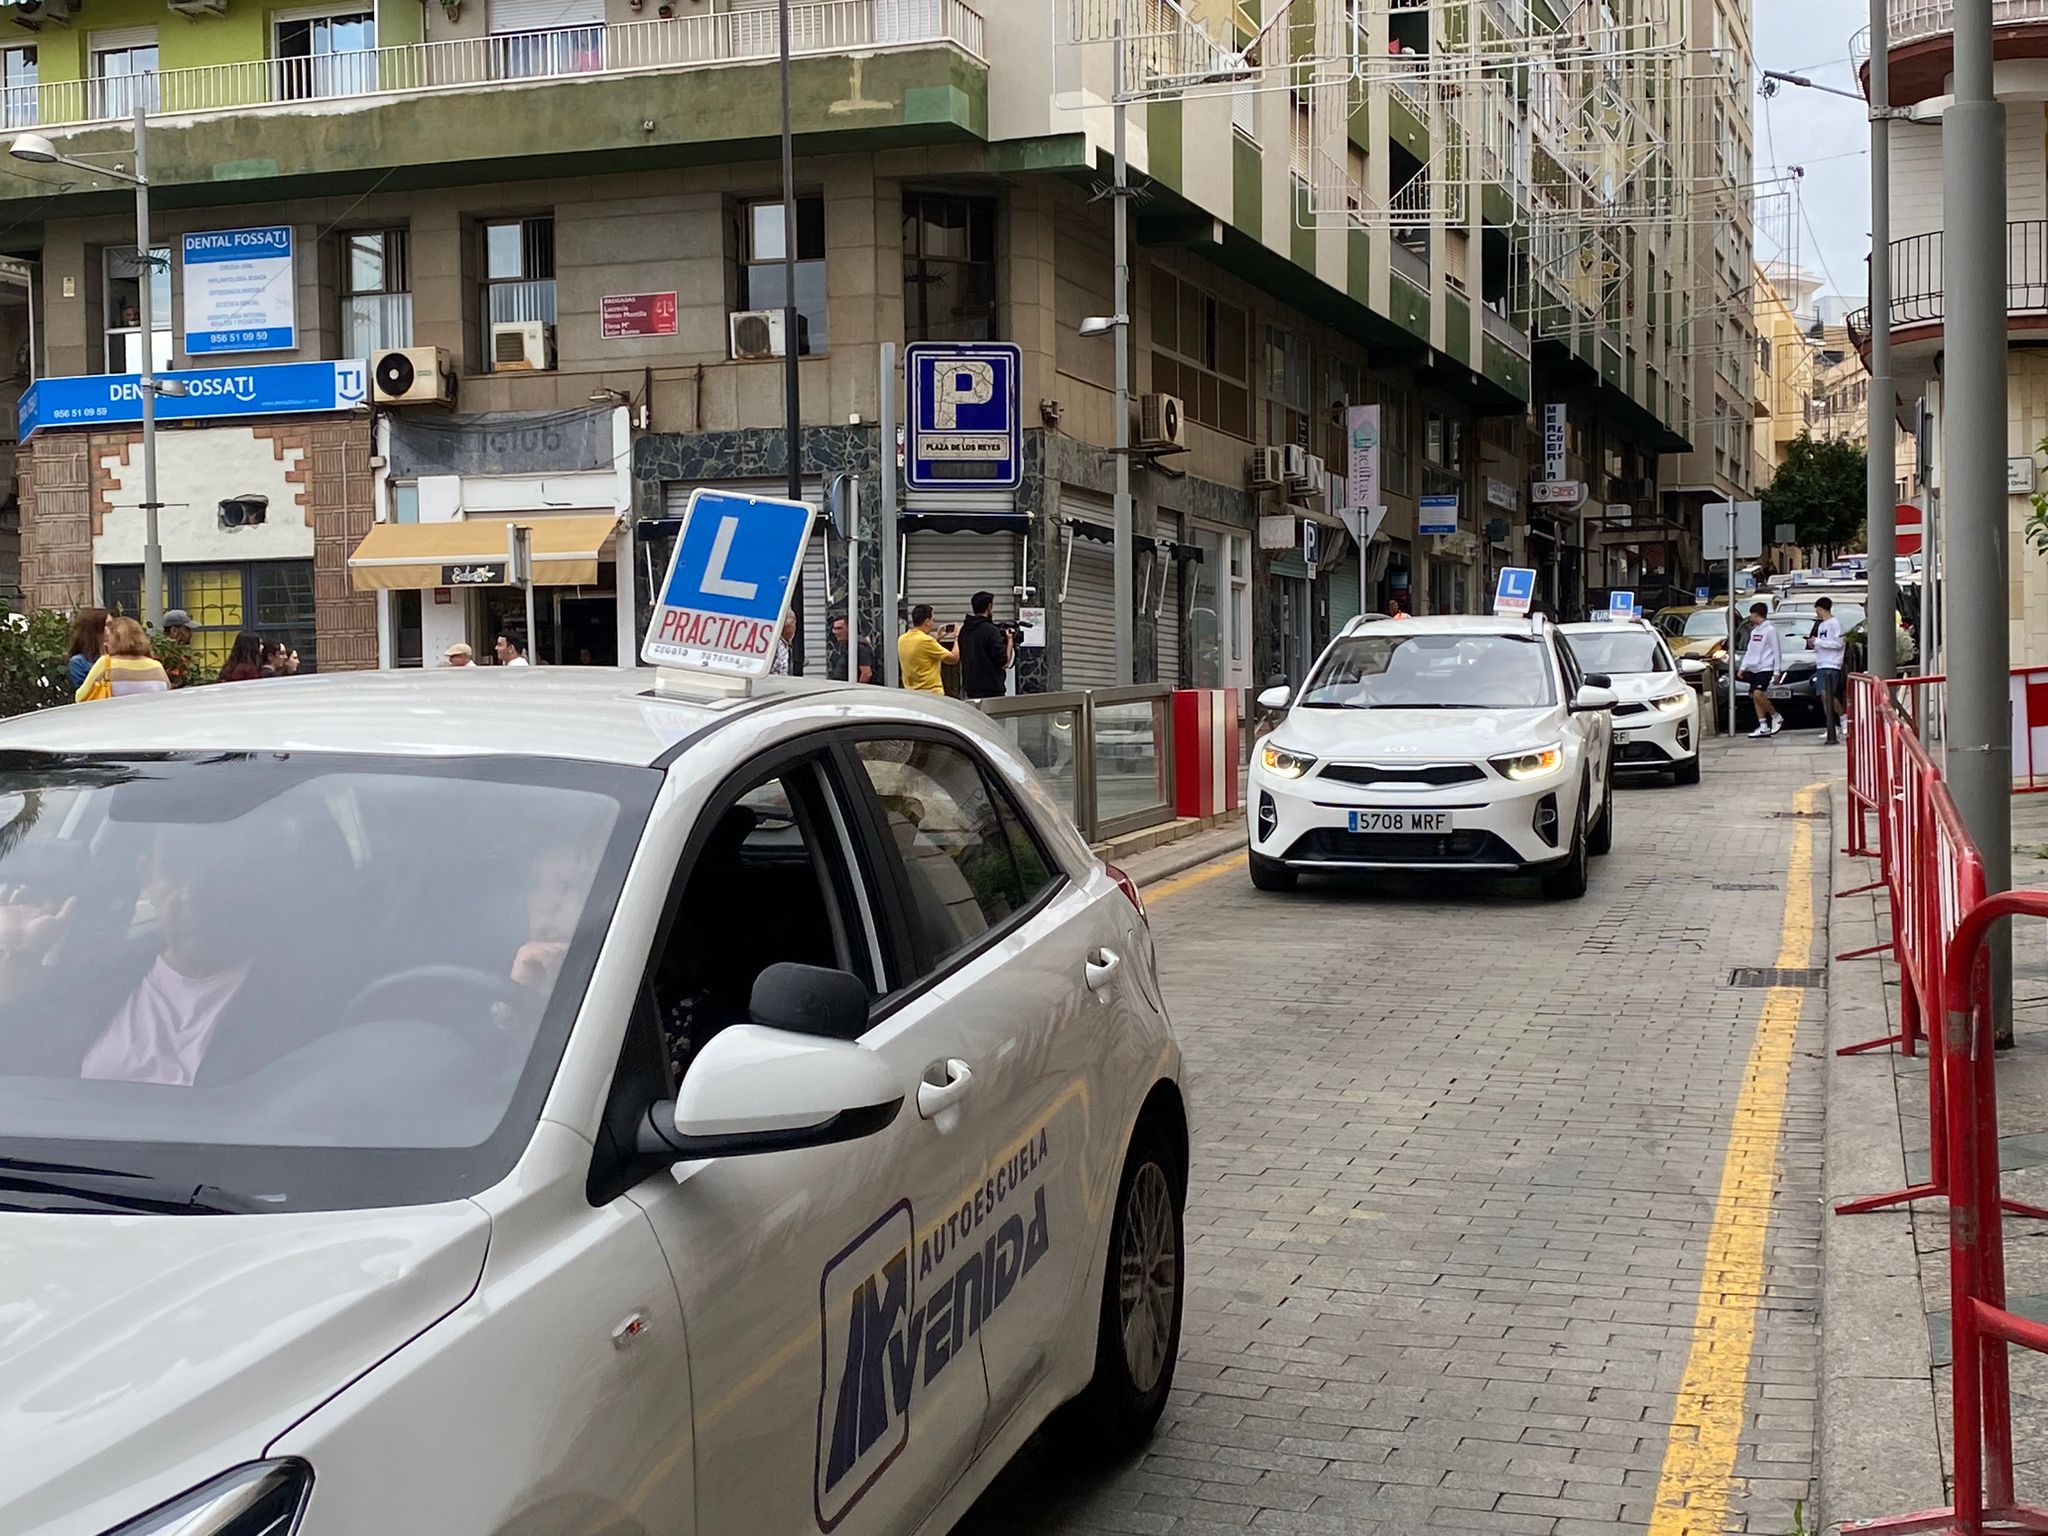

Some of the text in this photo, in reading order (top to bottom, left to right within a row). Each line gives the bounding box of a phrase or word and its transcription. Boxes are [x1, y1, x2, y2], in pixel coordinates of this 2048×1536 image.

[186, 231, 288, 249] DENTAL FOSSATI
[210, 331, 267, 343] 956 51 09 59
[338, 370, 361, 390] TI
[934, 361, 994, 429] P
[54, 407, 107, 418] 956 51 09 59
[926, 443, 1001, 451] PLAZA DE LOS REYES
[1547, 406, 1556, 480] MERCERIA
[1307, 526, 1316, 560] P
[699, 515, 758, 600] L
[1507, 574, 1523, 595] L
[1617, 595, 1627, 608] L
[1591, 611, 1610, 621] EUR
[658, 610, 773, 654] PRACTICAS
[1612, 732, 1626, 742] RF
[1360, 814, 1446, 830] 5708 MRF
[919, 1128, 1048, 1281] AUTOESCUELA
